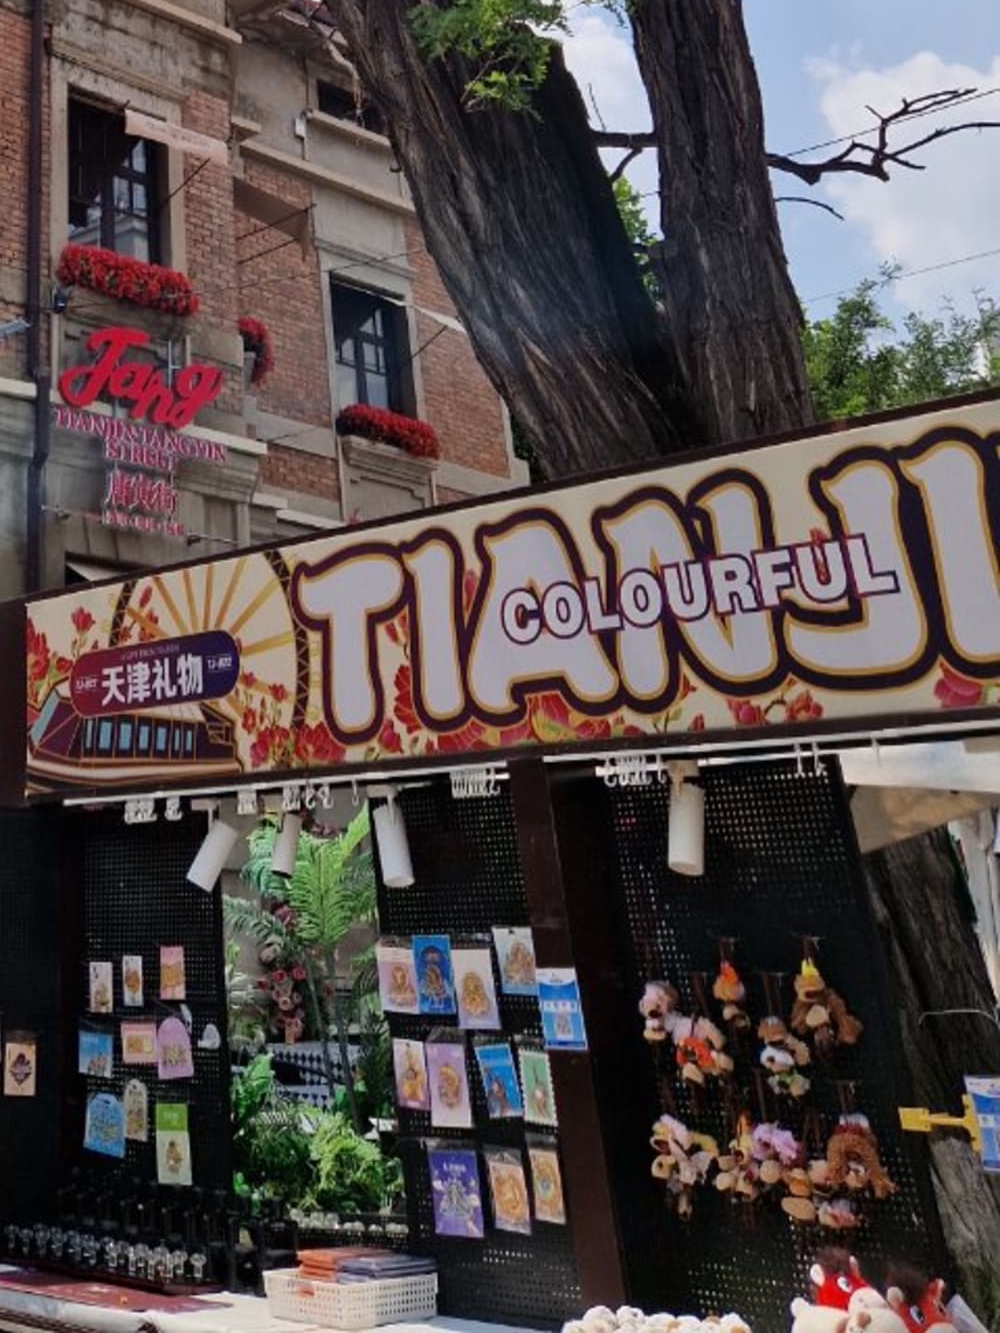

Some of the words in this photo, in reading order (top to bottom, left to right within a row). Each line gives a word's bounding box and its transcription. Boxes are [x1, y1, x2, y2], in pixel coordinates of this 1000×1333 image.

[59, 325, 223, 430] Tang
[300, 426, 1000, 744] TIANJI
[500, 533, 900, 645] COLOURFUL
[101, 653, 204, 706] 天津礼物
